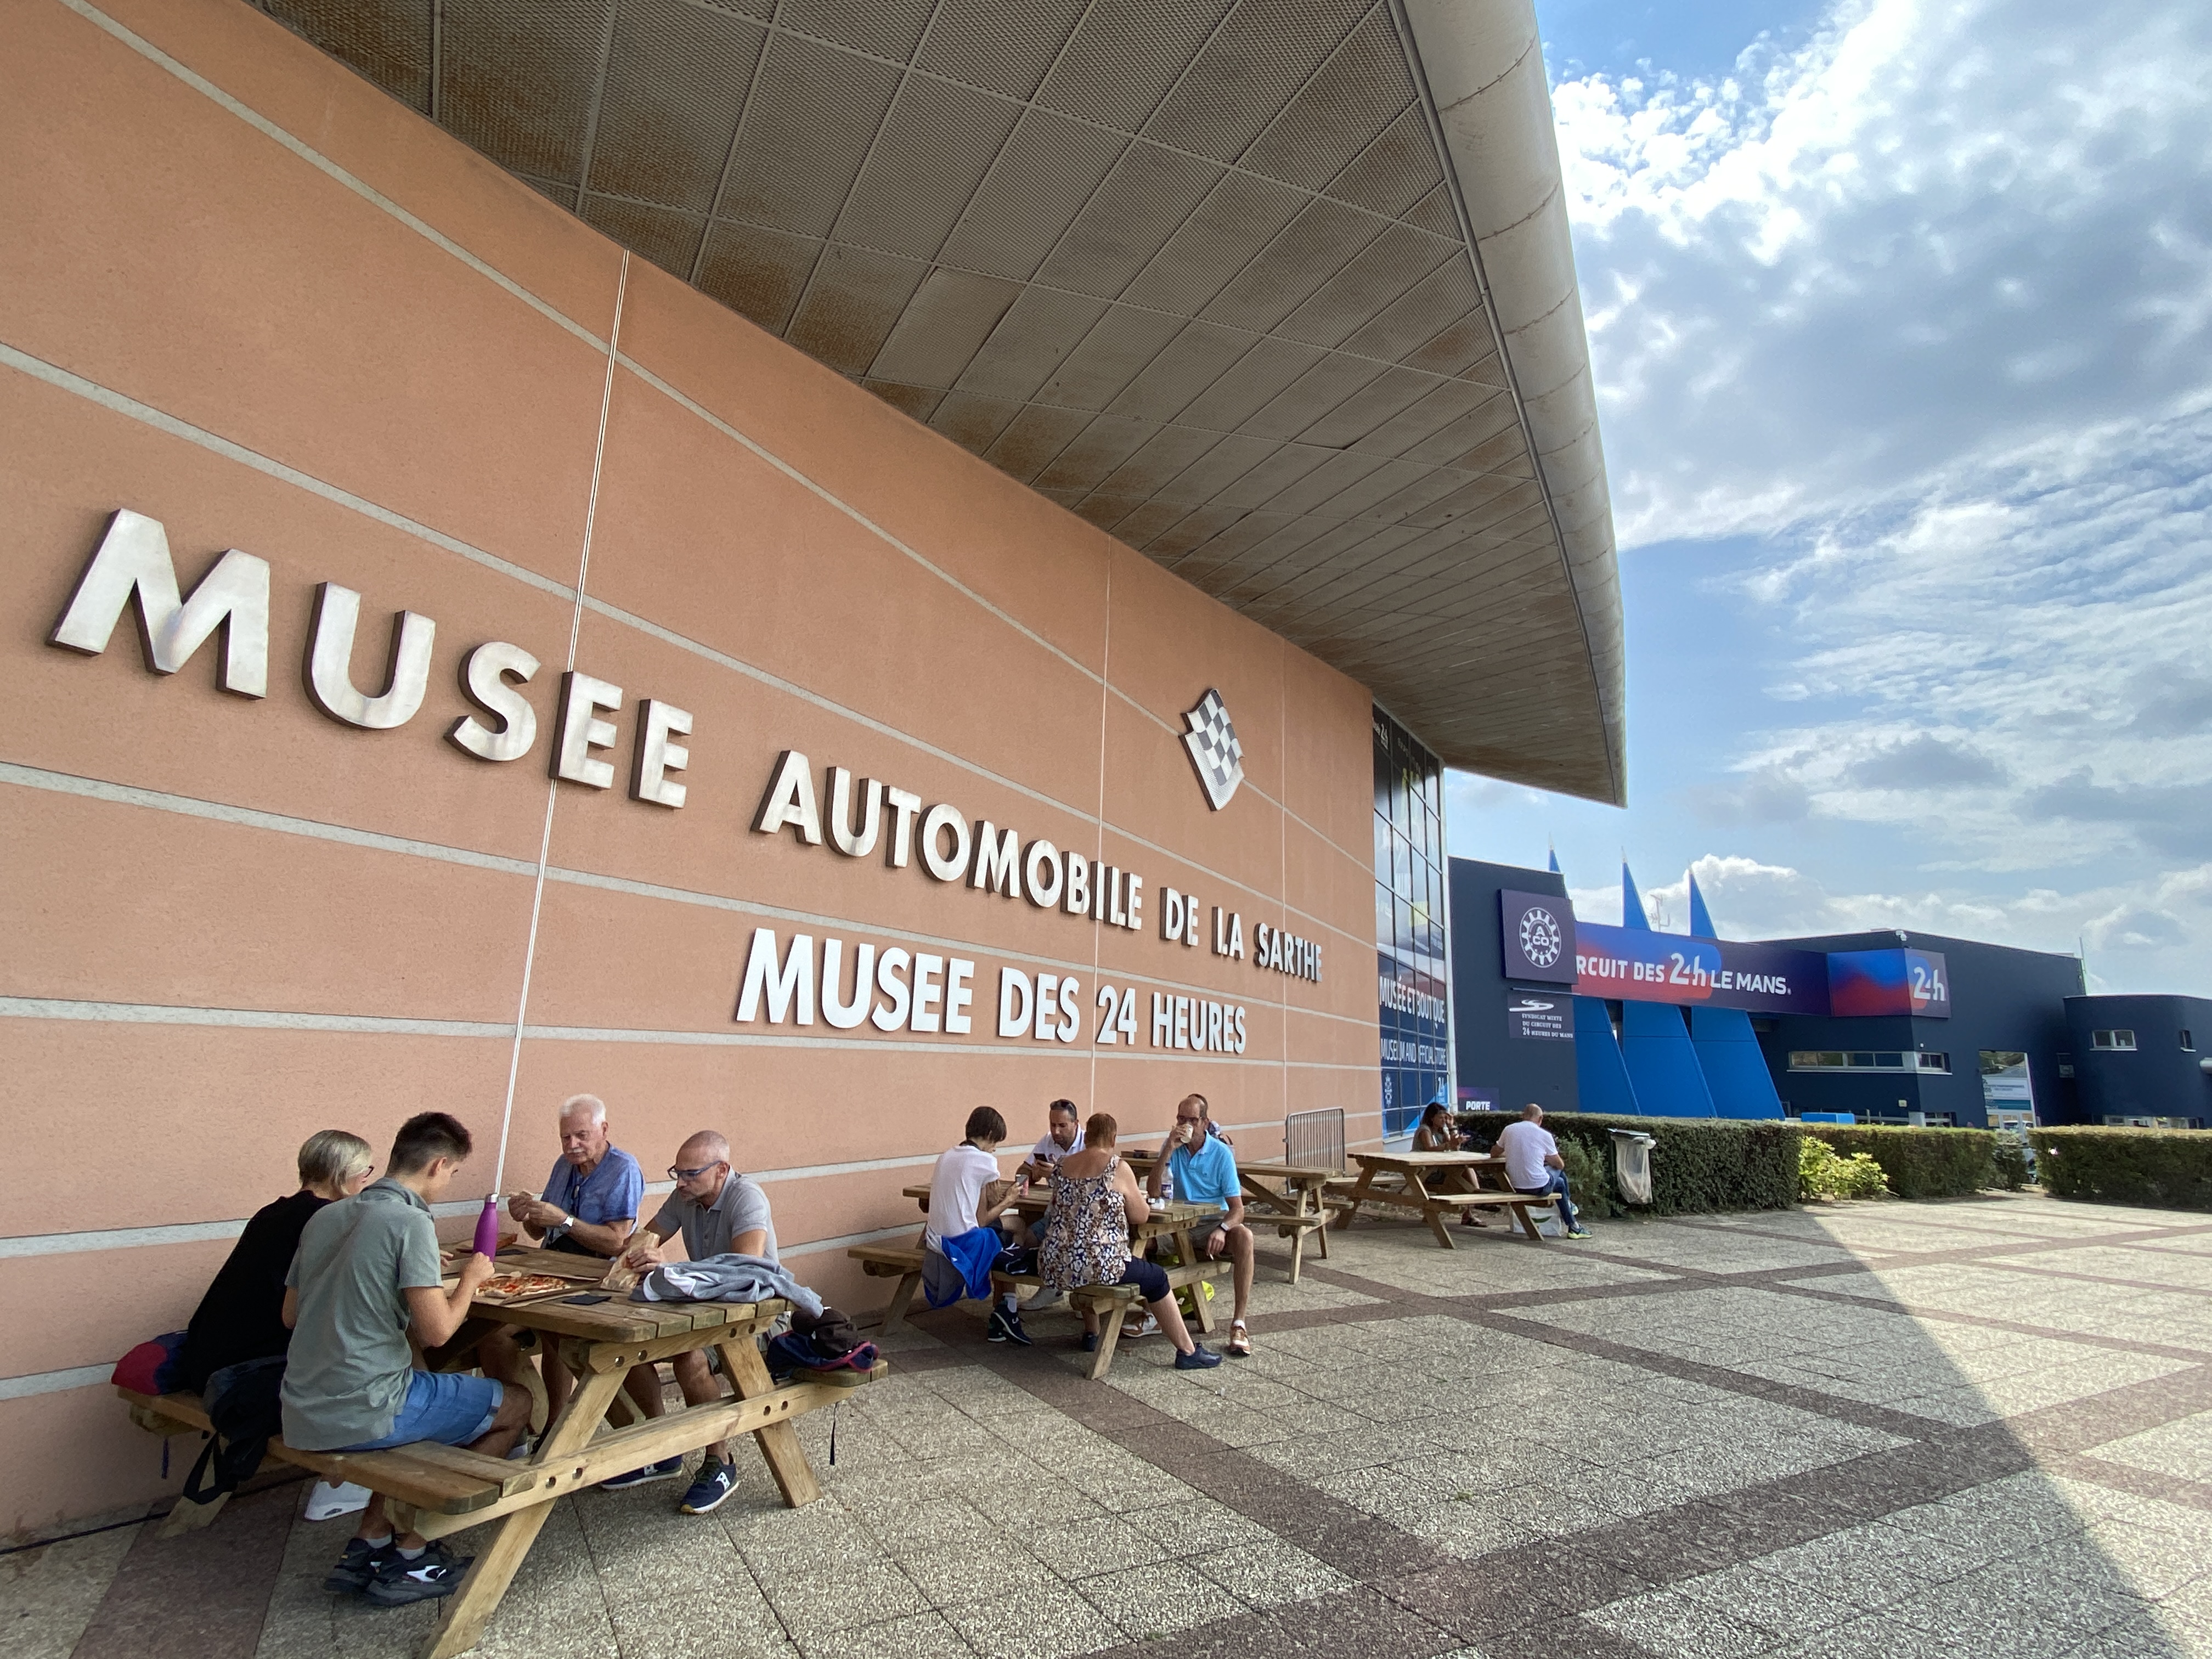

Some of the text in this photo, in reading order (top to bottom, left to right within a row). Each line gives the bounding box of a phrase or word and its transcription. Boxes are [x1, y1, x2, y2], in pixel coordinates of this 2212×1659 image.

[46, 508, 1323, 983] MUSEE AUTOMOBILE DE LA SARTHE
[1633, 961, 1664, 983] DES
[1710, 969, 1733, 990] LE
[736, 928, 1246, 1054] MUSEE DES 24 HEURES
[1522, 1026, 1530, 1036] 24
[1465, 1101, 1491, 1110] PORTE
